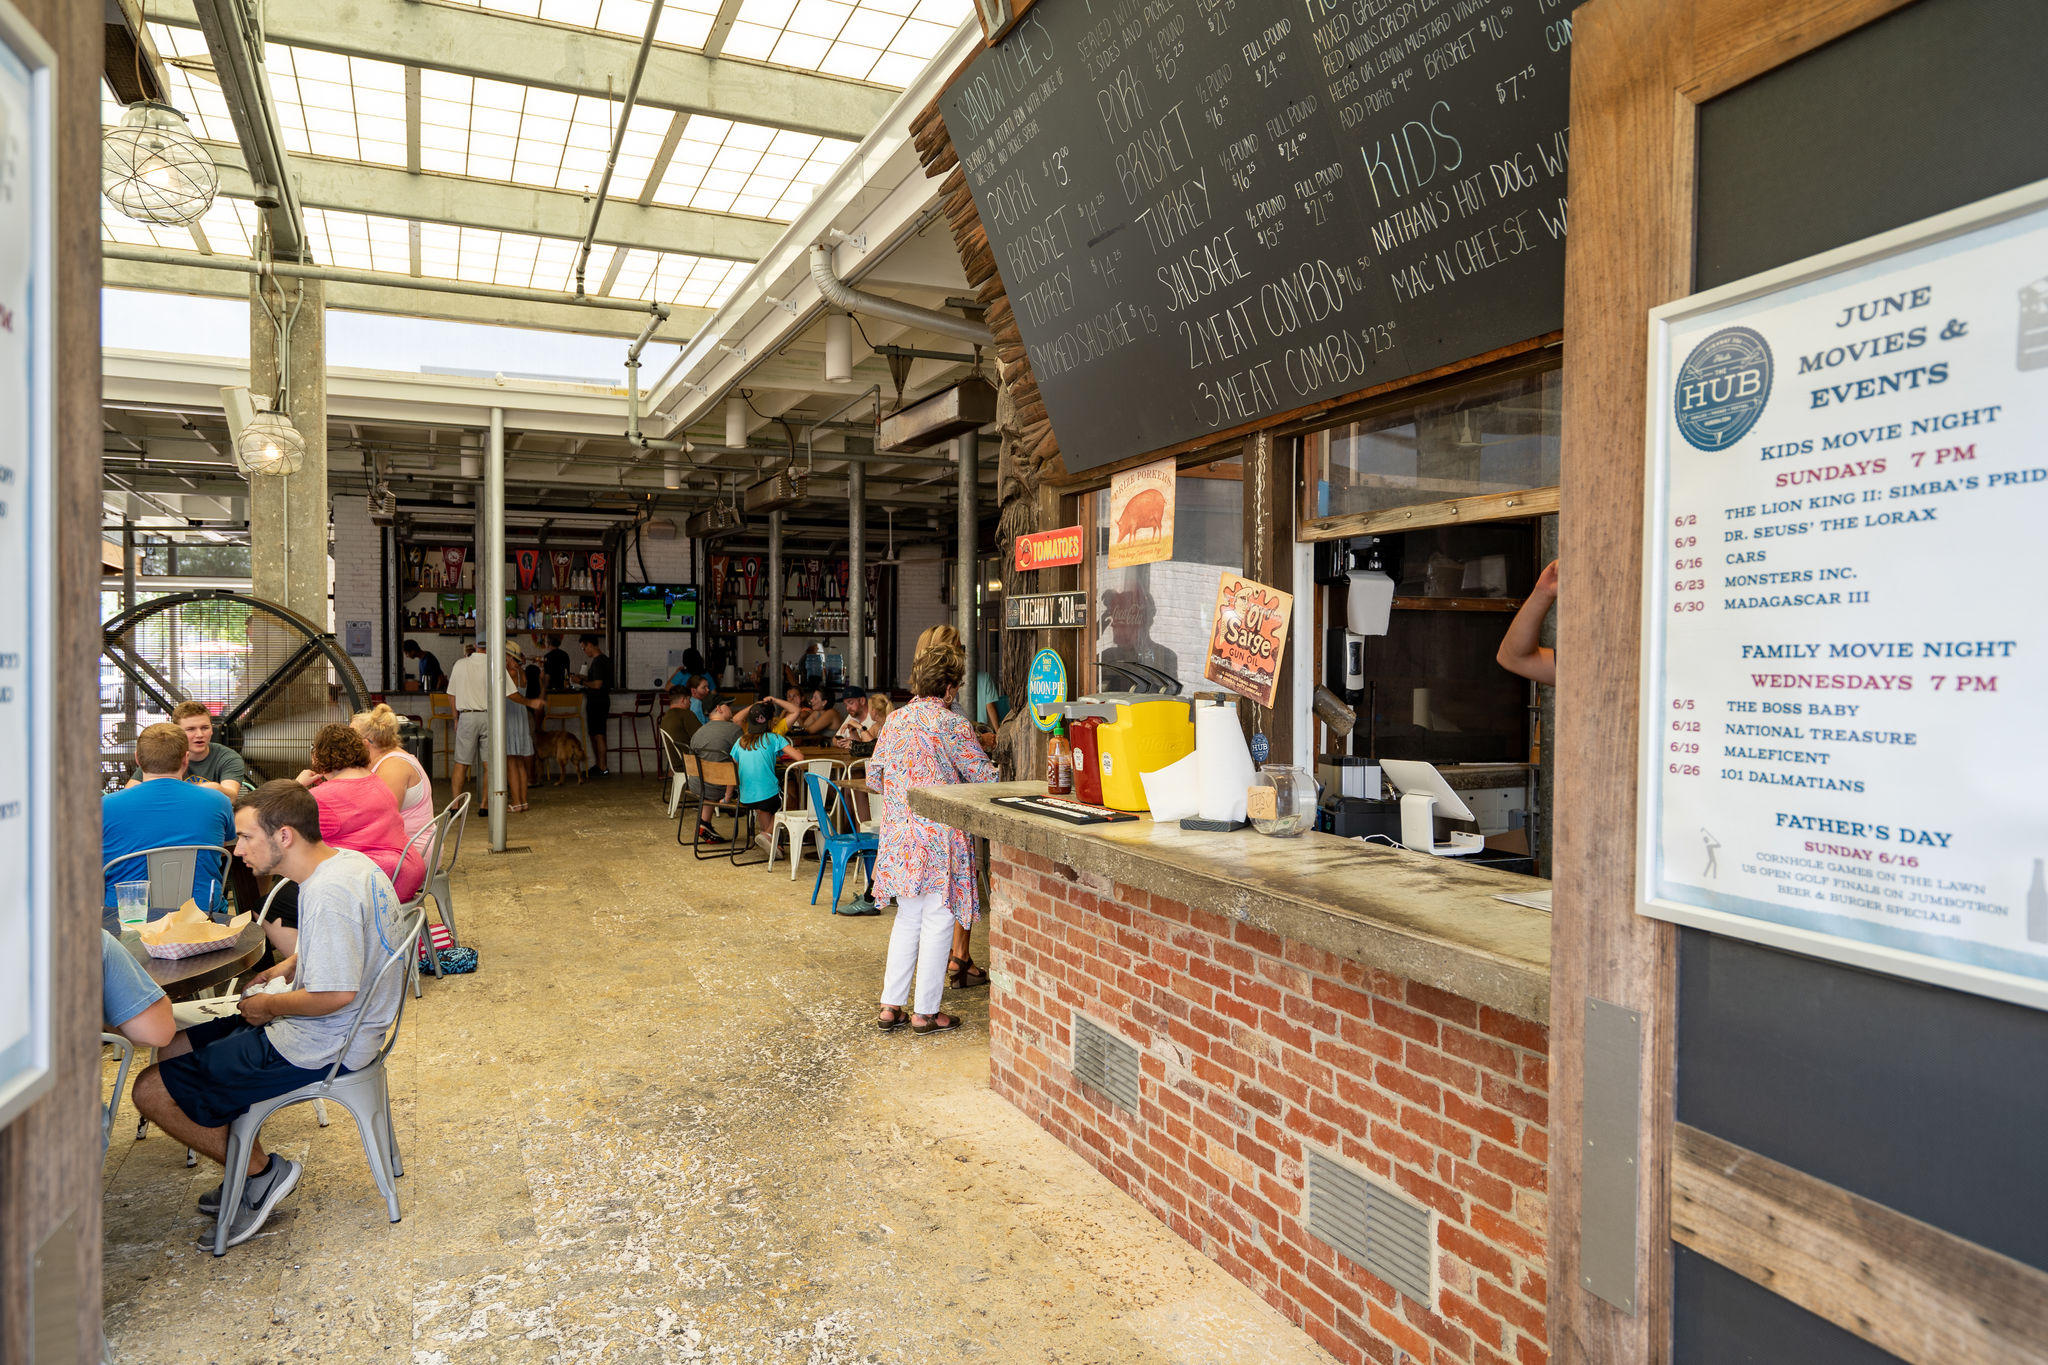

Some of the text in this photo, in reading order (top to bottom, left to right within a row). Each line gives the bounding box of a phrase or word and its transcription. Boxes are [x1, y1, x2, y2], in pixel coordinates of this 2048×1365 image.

[1096, 40, 1121, 73] SIDES
[1122, 19, 1143, 49] AND
[1157, 14, 1185, 51] POUND
[1242, 18, 1291, 66] FULL POUND
[1313, 13, 1350, 55] MIXED
[957, 8, 1054, 141] SANDWICHES
[1322, 49, 1345, 77] RED
[1328, 12, 1451, 103] HERB OR LEMON MUSTARD
[1339, 102, 1364, 131] ADD
[1363, 88, 1395, 116] PORK
[1423, 27, 1476, 80] BRISKET
[1097, 65, 1152, 144] PORK
[1265, 94, 1318, 142] FULL POUND
[1115, 100, 1194, 206] BRISKET
[1205, 63, 1232, 97] POUND
[1360, 100, 1463, 208] KIDS
[987, 168, 1037, 235] PORK
[1134, 133, 1259, 255] TURKEY POUND
[1294, 162, 1344, 200] FULL POUND
[1370, 190, 1450, 256] NATHAN'S
[1452, 172, 1487, 219] HOT
[1489, 152, 1538, 199] DOG
[1006, 204, 1073, 284] BRISKET
[1157, 194, 1287, 312] SAUSAGE POUND
[1454, 209, 1537, 275] CHEESE
[1019, 265, 1076, 328] TURKEY
[1179, 320, 1204, 370] 2
[1196, 295, 1258, 366] MEAT
[1260, 259, 1343, 337] COMBO
[1835, 286, 1932, 327] JUNE
[1030, 332, 1080, 383] SMOKED
[1075, 301, 1136, 362] SAUSAGE
[1798, 318, 1969, 376] MOVIES &
[1198, 382, 1220, 427] 3
[1216, 359, 1280, 420] MEAT
[1285, 329, 1365, 396] COMBO
[1682, 369, 1761, 411] HUB
[1809, 361, 1950, 410] EVENTS
[1760, 405, 2003, 462] KIDS MOVIE NIGHT
[1775, 443, 1978, 488] SUNDAYS 7 PM
[1674, 514, 1697, 528] 6/2
[1725, 507, 1758, 521] THE
[1761, 499, 1803, 516] LION
[1809, 491, 1857, 509] KING
[1889, 475, 1980, 499] SIMBA'S
[1033, 536, 1079, 562] TOMATOES
[1674, 536, 1697, 550] 6/9
[1725, 529, 1749, 543] DR.
[1820, 517, 1860, 532] THE
[1865, 507, 1938, 529] LORAX
[1674, 567, 1858, 593] 6/23 MONSTERS INC.
[1675, 551, 1767, 571] 6/16 CARS
[1019, 597, 1054, 625] HIGHWAY
[1058, 596, 1075, 624] 30A
[1673, 600, 1705, 614] 6/30
[1724, 592, 1842, 610] MADAGASCAR
[1226, 618, 1271, 658] Sarge
[1229, 648, 1258, 667] GUN OIL
[1741, 641, 2017, 659] FAMILY MOVIE NIGHT
[1751, 673, 1999, 692] WEDNESDAYS 7 PM
[1672, 699, 1860, 717] 6/5 THE BOSS BABY
[1252, 743, 1268, 751] HUB
[1670, 742, 1831, 765] 6/19 MALEFICENT
[1672, 720, 1918, 746] 6/12 NATIONAL TREASURE
[1669, 763, 1866, 793] 6/26 101 DALMATIANS
[1775, 812, 1953, 848] FATHER'S DAY
[1756, 851, 1987, 895] CORNHOLE GAMES ON THE LAWN
[1804, 841, 1920, 868] SUNDAY 6/16
[1741, 863, 2009, 917] US OPEN GOLF FINALS ON JUMBOTRON
[1777, 885, 1811, 899] BEER
[1829, 892, 1883, 912] BURGER
[1886, 905, 1962, 925] SPECIALS
